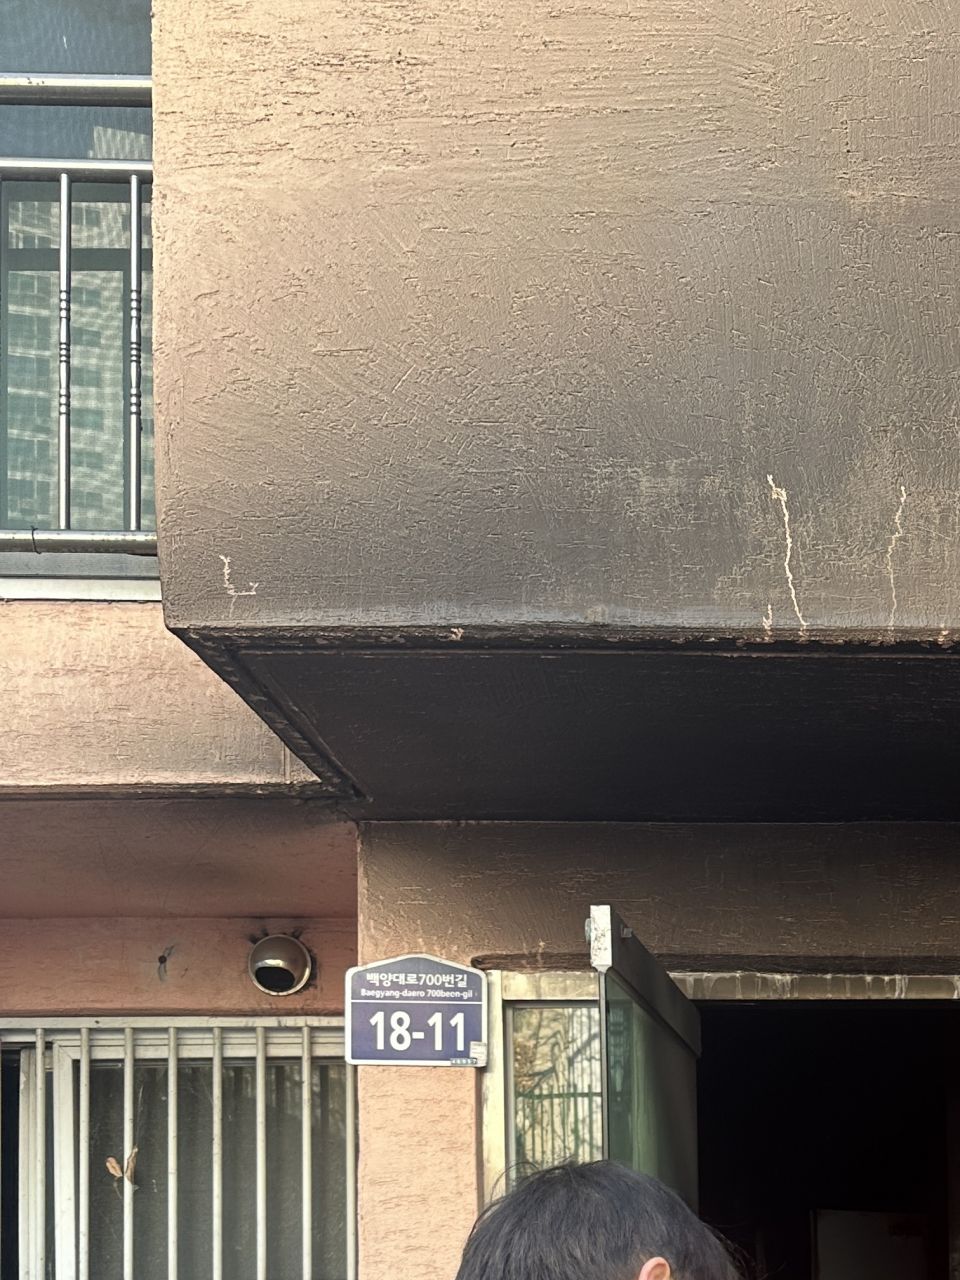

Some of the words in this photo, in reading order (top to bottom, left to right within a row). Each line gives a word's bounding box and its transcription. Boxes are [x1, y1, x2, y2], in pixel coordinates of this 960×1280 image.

[366, 973, 468, 988] 백양대로700번길
[360, 988, 425, 999] Baegyang-daero
[369, 1011, 465, 1052] 18-11
